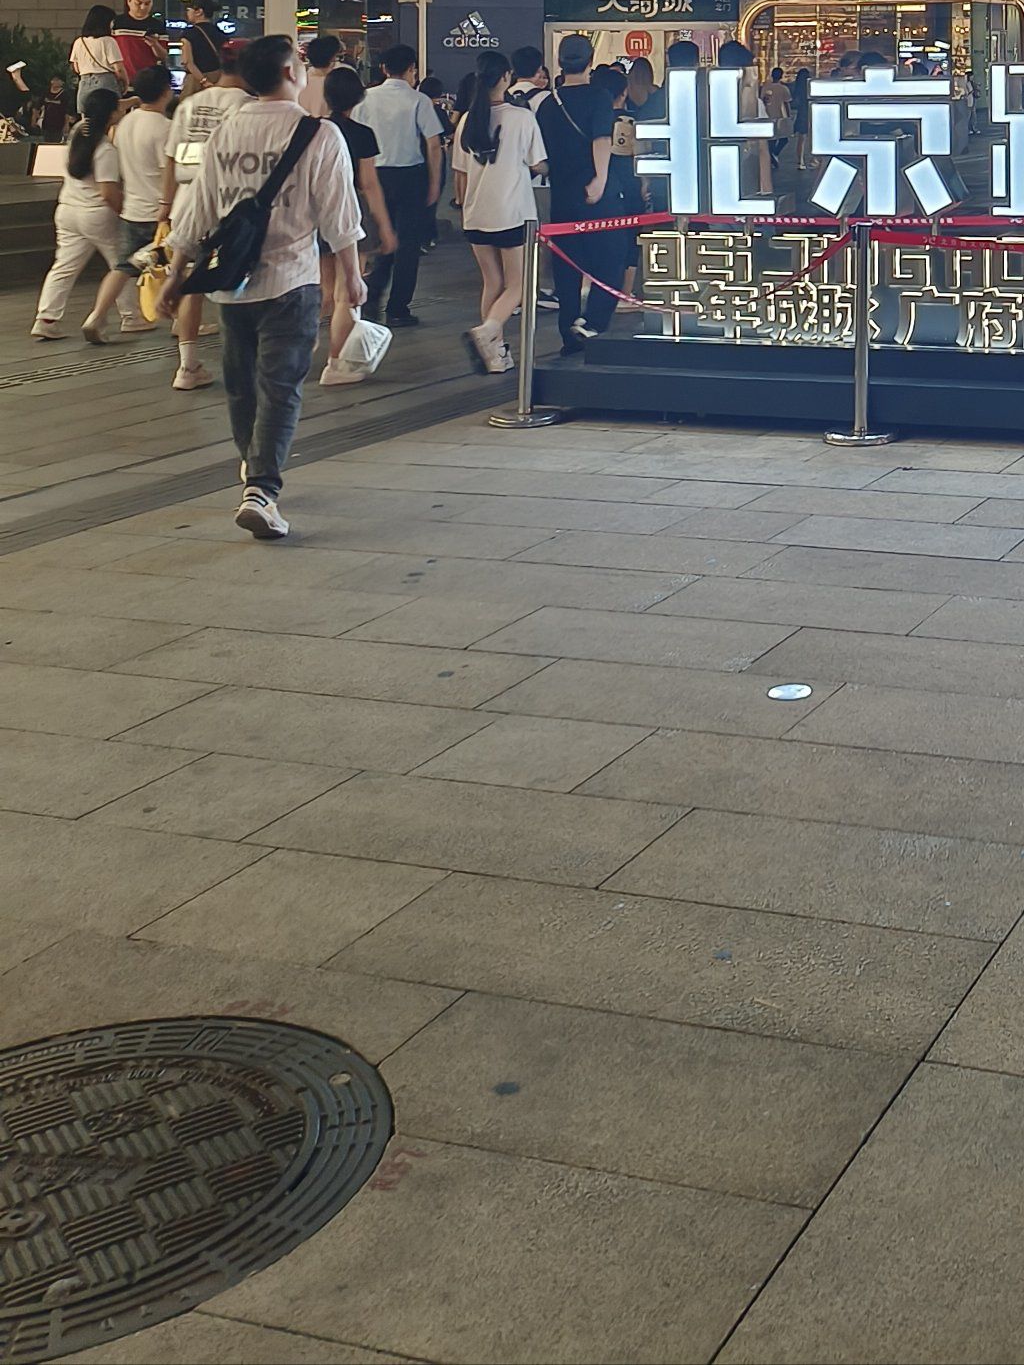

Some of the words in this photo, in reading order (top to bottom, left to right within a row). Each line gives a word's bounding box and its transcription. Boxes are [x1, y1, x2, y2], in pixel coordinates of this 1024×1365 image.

[442, 34, 500, 48] adidas
[216, 151, 290, 175] WOR
[219, 185, 296, 209] WK
